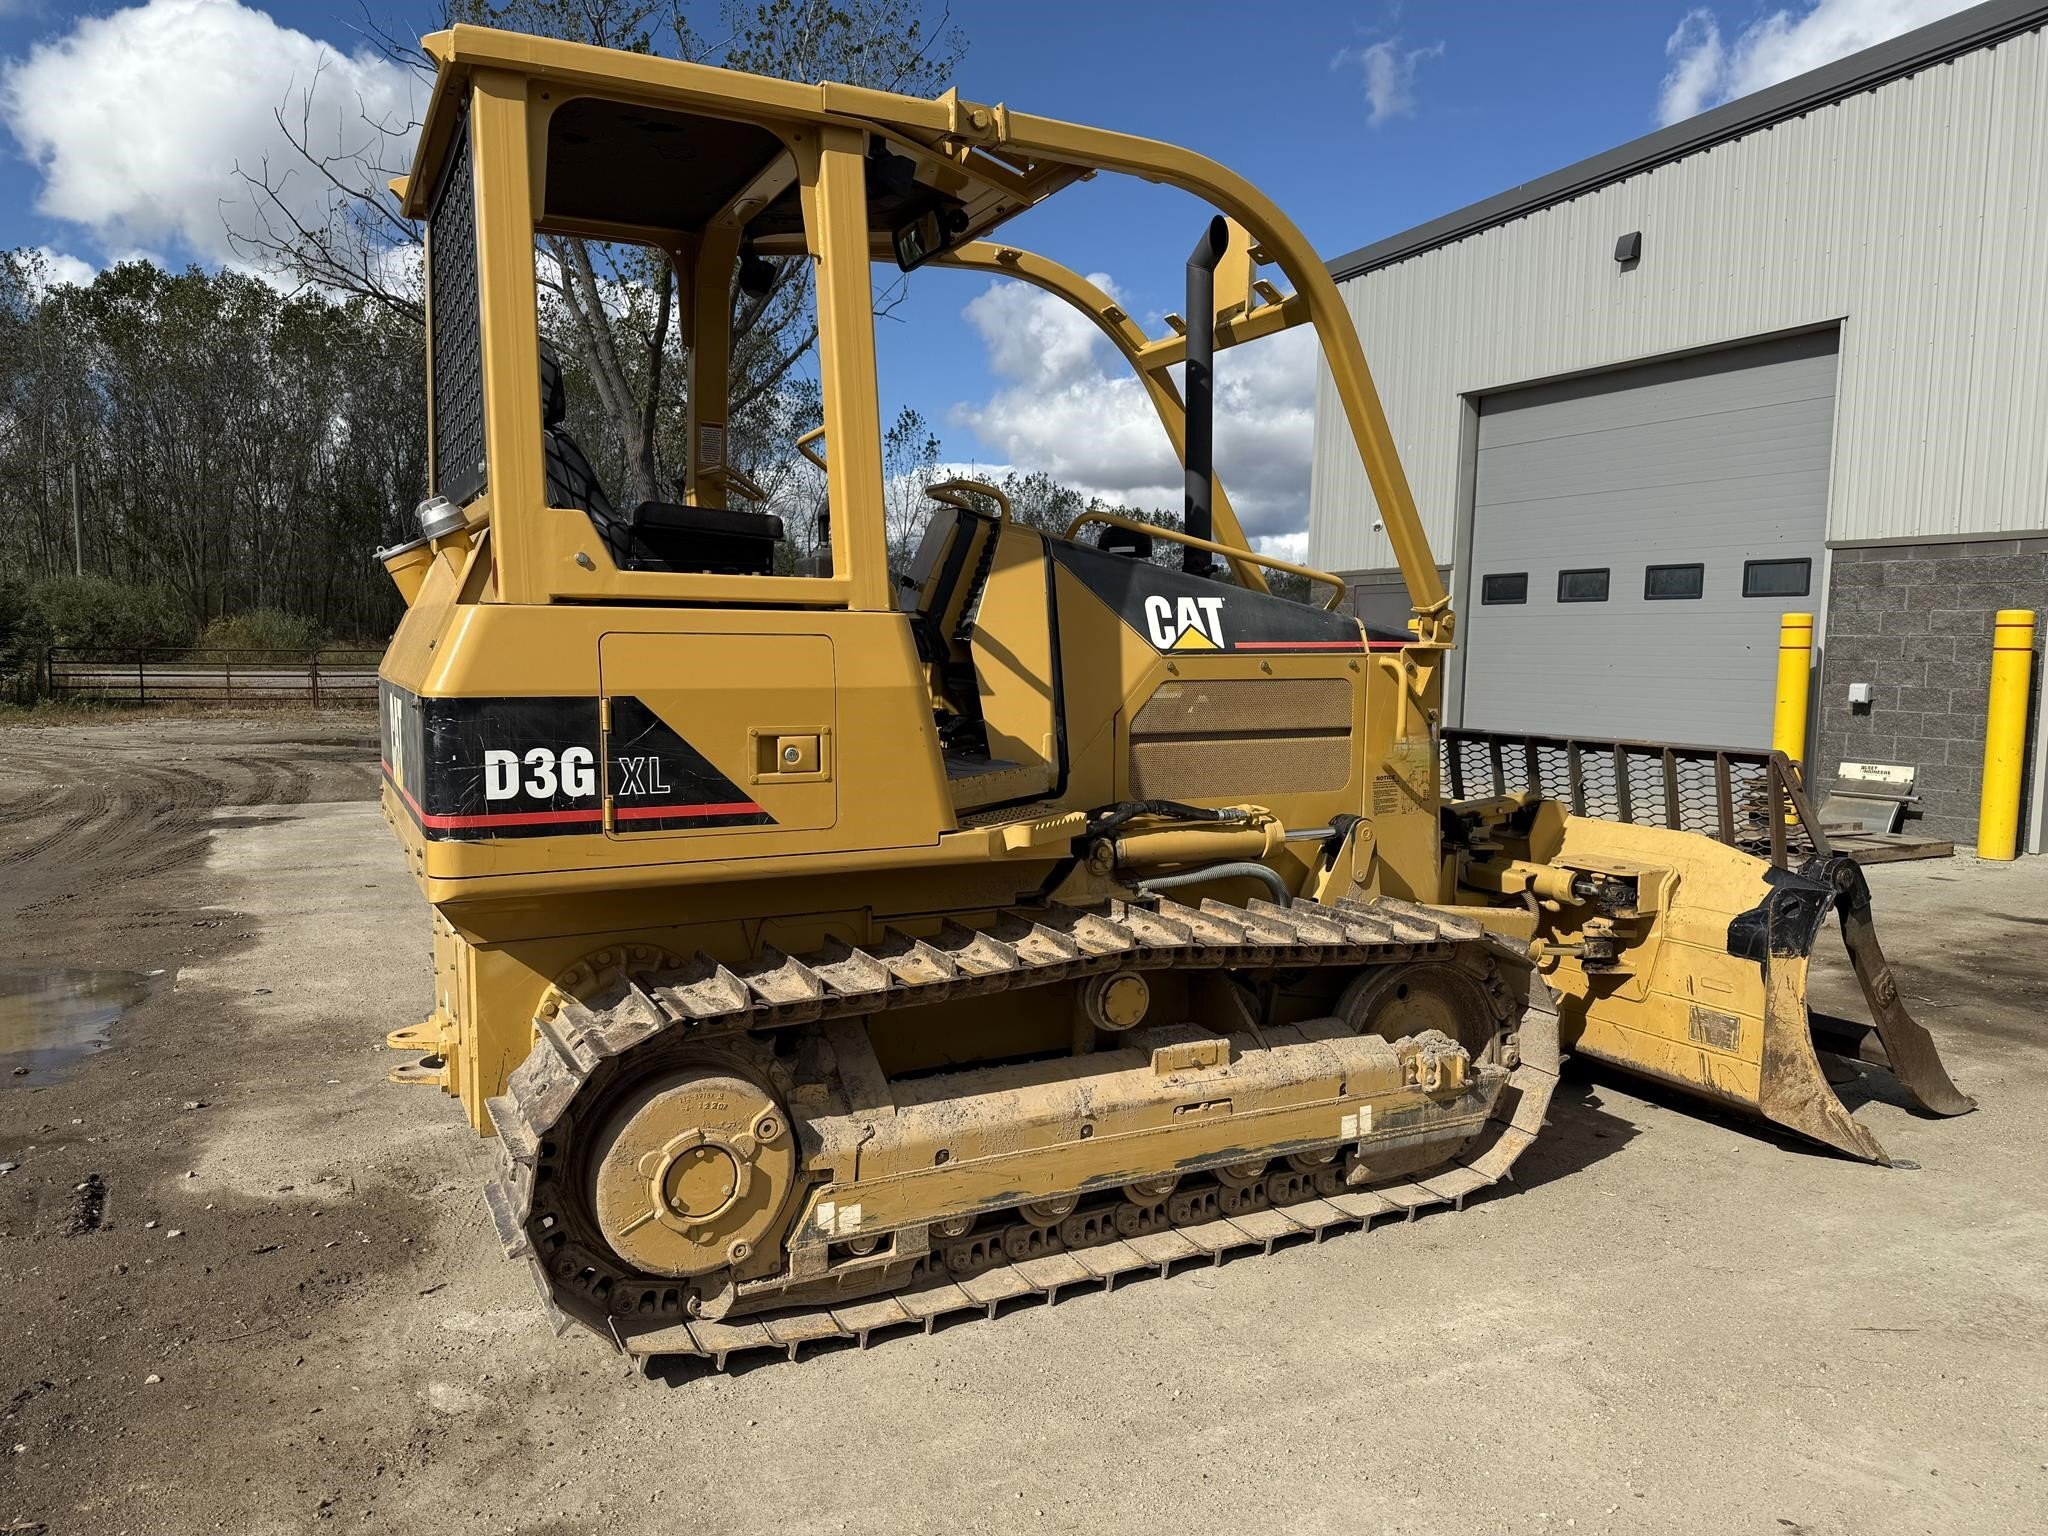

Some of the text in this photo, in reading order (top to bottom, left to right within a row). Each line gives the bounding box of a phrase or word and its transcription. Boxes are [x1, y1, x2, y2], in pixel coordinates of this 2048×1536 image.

[1144, 595, 1225, 650] CAT
[485, 746, 671, 800] D3G XL
